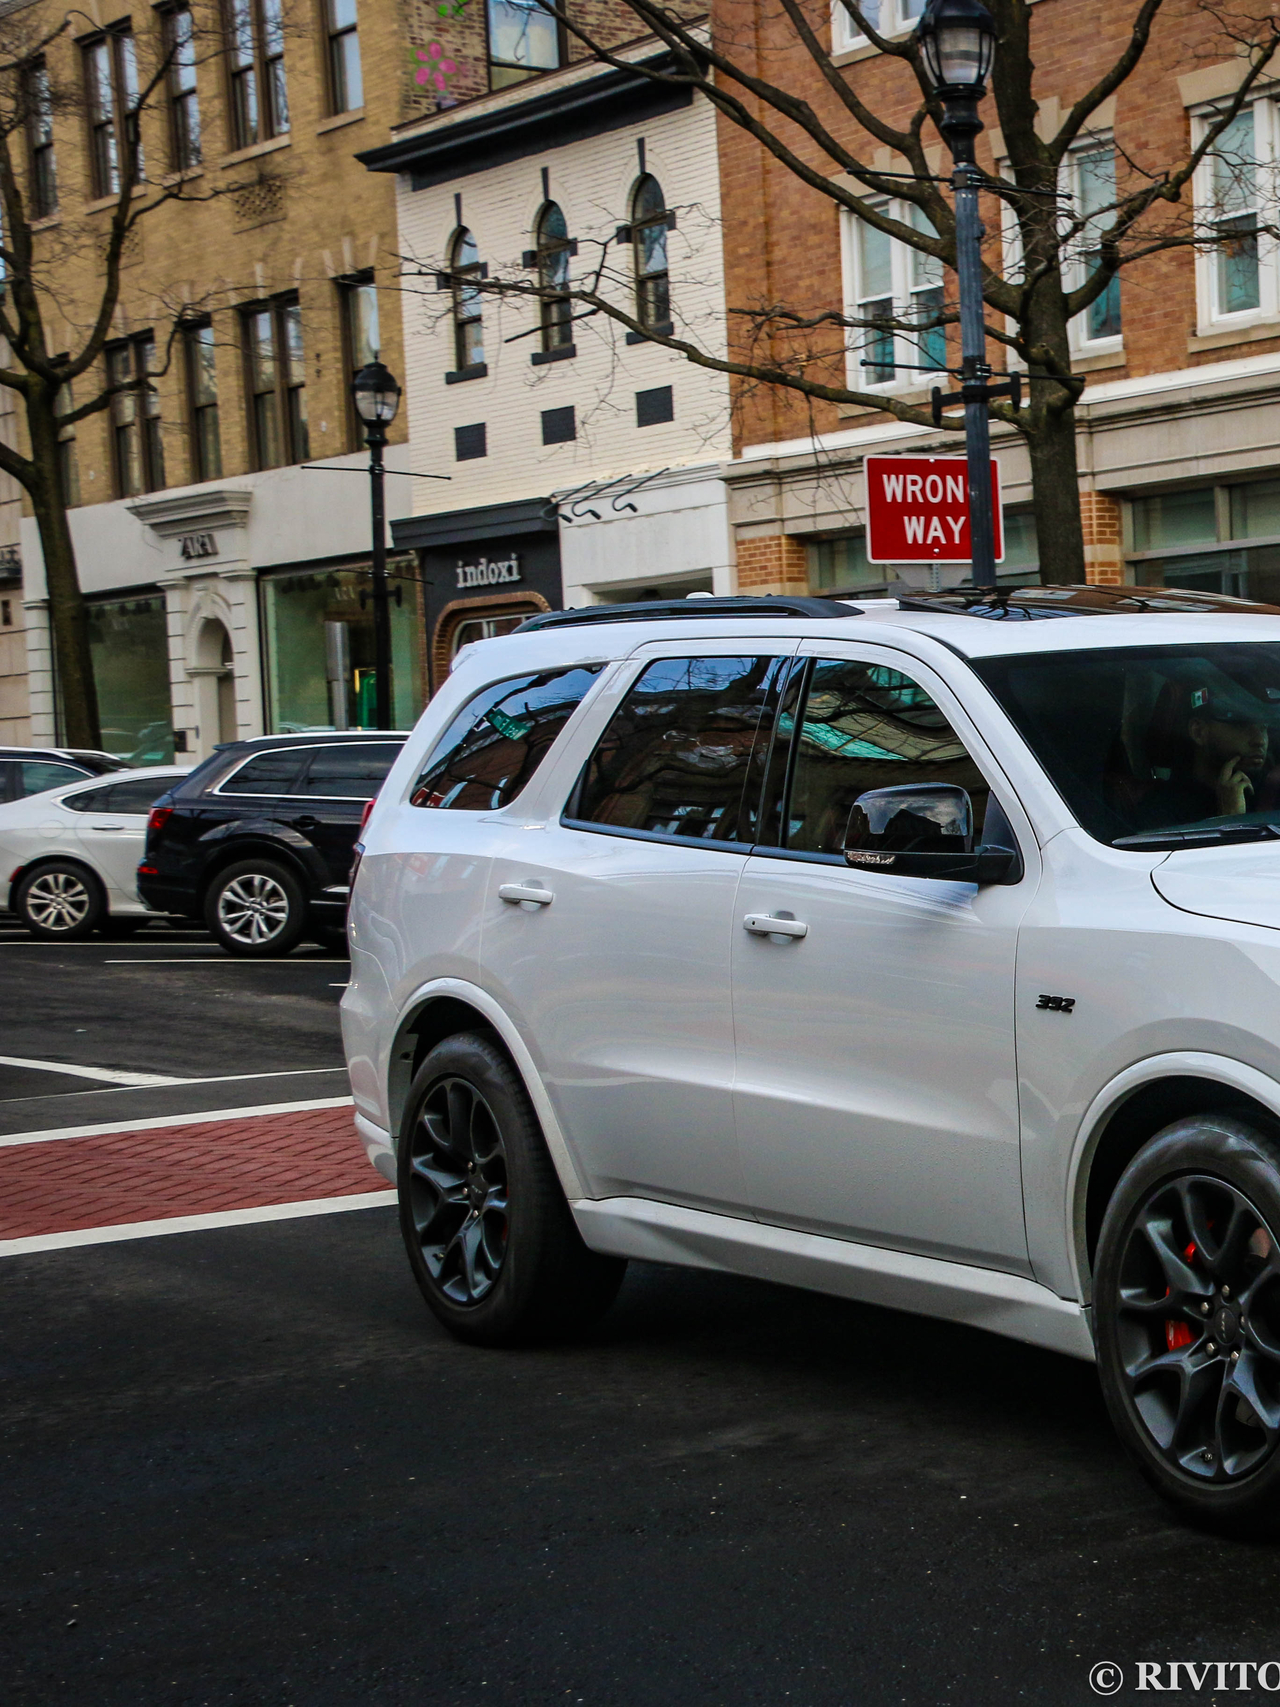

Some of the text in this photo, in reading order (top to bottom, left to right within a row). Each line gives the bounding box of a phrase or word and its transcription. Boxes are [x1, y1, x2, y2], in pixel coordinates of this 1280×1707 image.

[882, 474, 969, 503] WRON
[903, 516, 966, 544] WAY
[456, 553, 521, 588] indoxi
[1035, 994, 1076, 1014] 392
